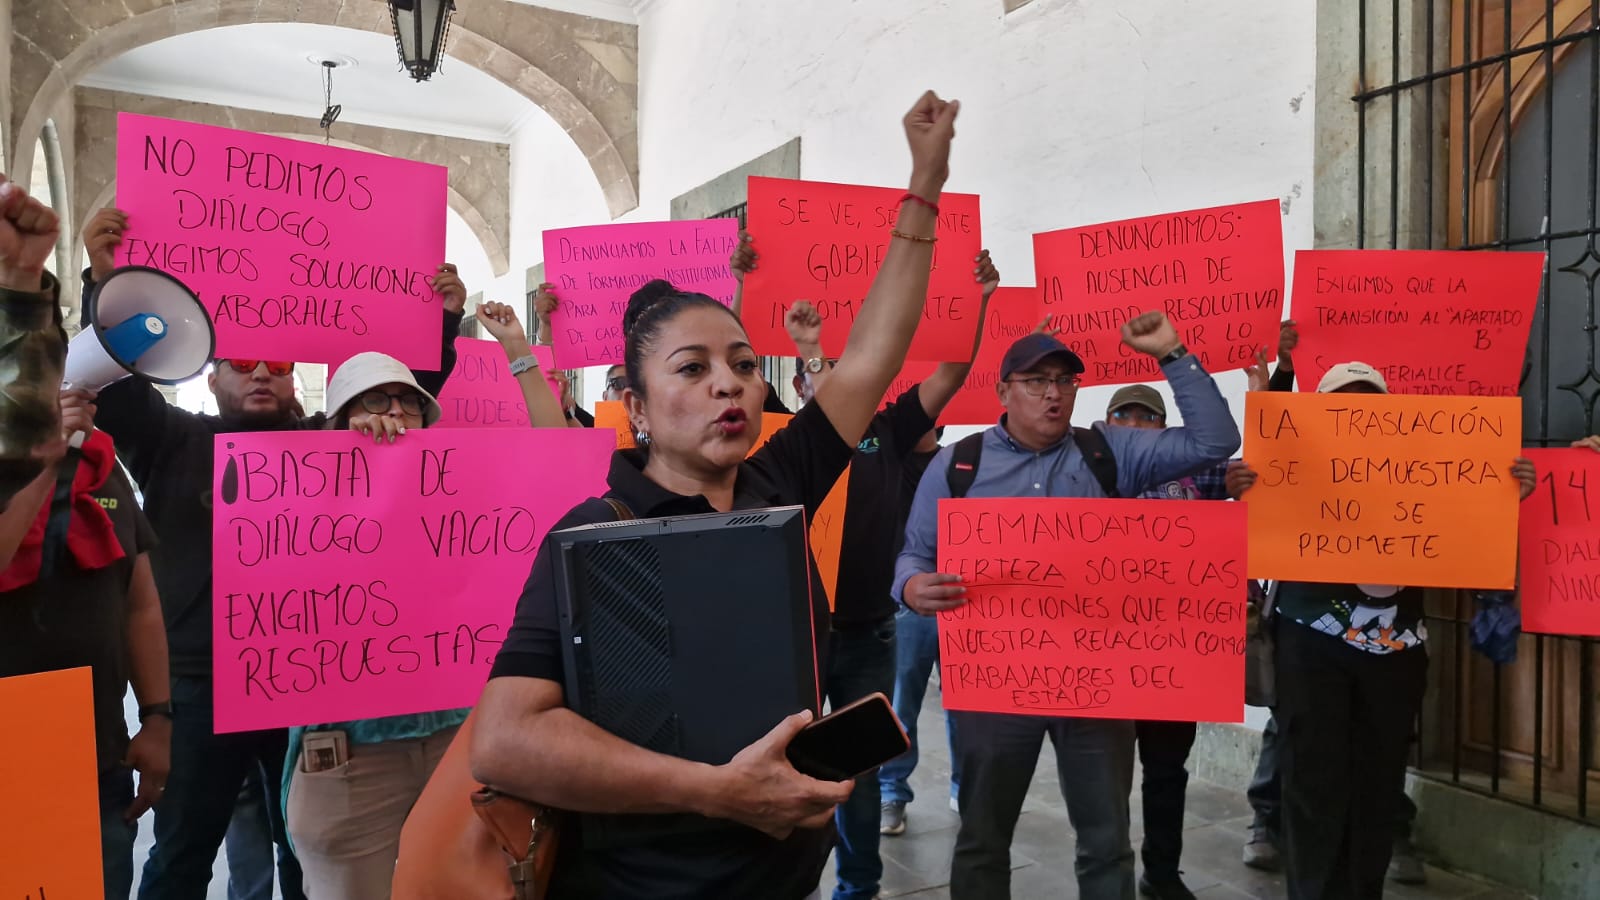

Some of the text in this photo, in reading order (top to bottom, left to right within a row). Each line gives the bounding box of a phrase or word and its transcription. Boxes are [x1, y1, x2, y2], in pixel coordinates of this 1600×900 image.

[144, 135, 372, 211] NO PEDIMOS
[173, 189, 331, 249] DIÁLOGO,
[778, 198, 810, 226] SE
[828, 202, 861, 229] VE,
[937, 212, 971, 234] NTE
[669, 238, 687, 256] LA
[1079, 211, 1243, 259] DENUNCIAMOS:
[124, 238, 435, 303] EXIGIMOS SOLUCIONES
[560, 273, 580, 291] DE
[807, 243, 937, 290] GOBIE
[1043, 256, 1233, 304] LA AUSENCIA DE
[1316, 267, 1468, 296] EXIGIMOS QUE LA
[195, 291, 369, 336] ABORALES
[562, 300, 598, 319] PARA
[1163, 288, 1280, 323] RESOLUTIVA
[1315, 302, 1409, 328] TRANSICIÓN
[1419, 310, 1440, 326] AL
[1226, 322, 1252, 342] LO
[585, 345, 625, 361] LAB
[1093, 358, 1160, 380] DEMAND
[1226, 343, 1259, 364] LEY
[1379, 364, 1466, 382] TERIALICE
[437, 396, 529, 426] TUDES
[1259, 406, 1503, 440] LA TRASLACIÓN
[221, 441, 459, 505] ¡BASTA DE
[1263, 456, 1502, 488] SE DEMUESTRA
[1321, 498, 1425, 525] NO SE
[228, 508, 384, 567] DIÁLOGO
[947, 511, 1196, 548] DEMANDAMOS
[1299, 532, 1440, 559] PROMETE
[1542, 538, 1600, 566] DIAL
[944, 556, 1240, 589] CERTEZA SOBRE LAS
[225, 580, 399, 641] EXIGIMOS
[1121, 596, 1168, 625] QUE
[1178, 596, 1243, 624] RIGEN
[945, 625, 1247, 657] NUESTRA RELACIÓN COMO
[238, 623, 507, 701] RESPUESTAS
[945, 662, 1185, 695] TRABAJADORES DEL
[1012, 687, 1112, 707] ESTADO
